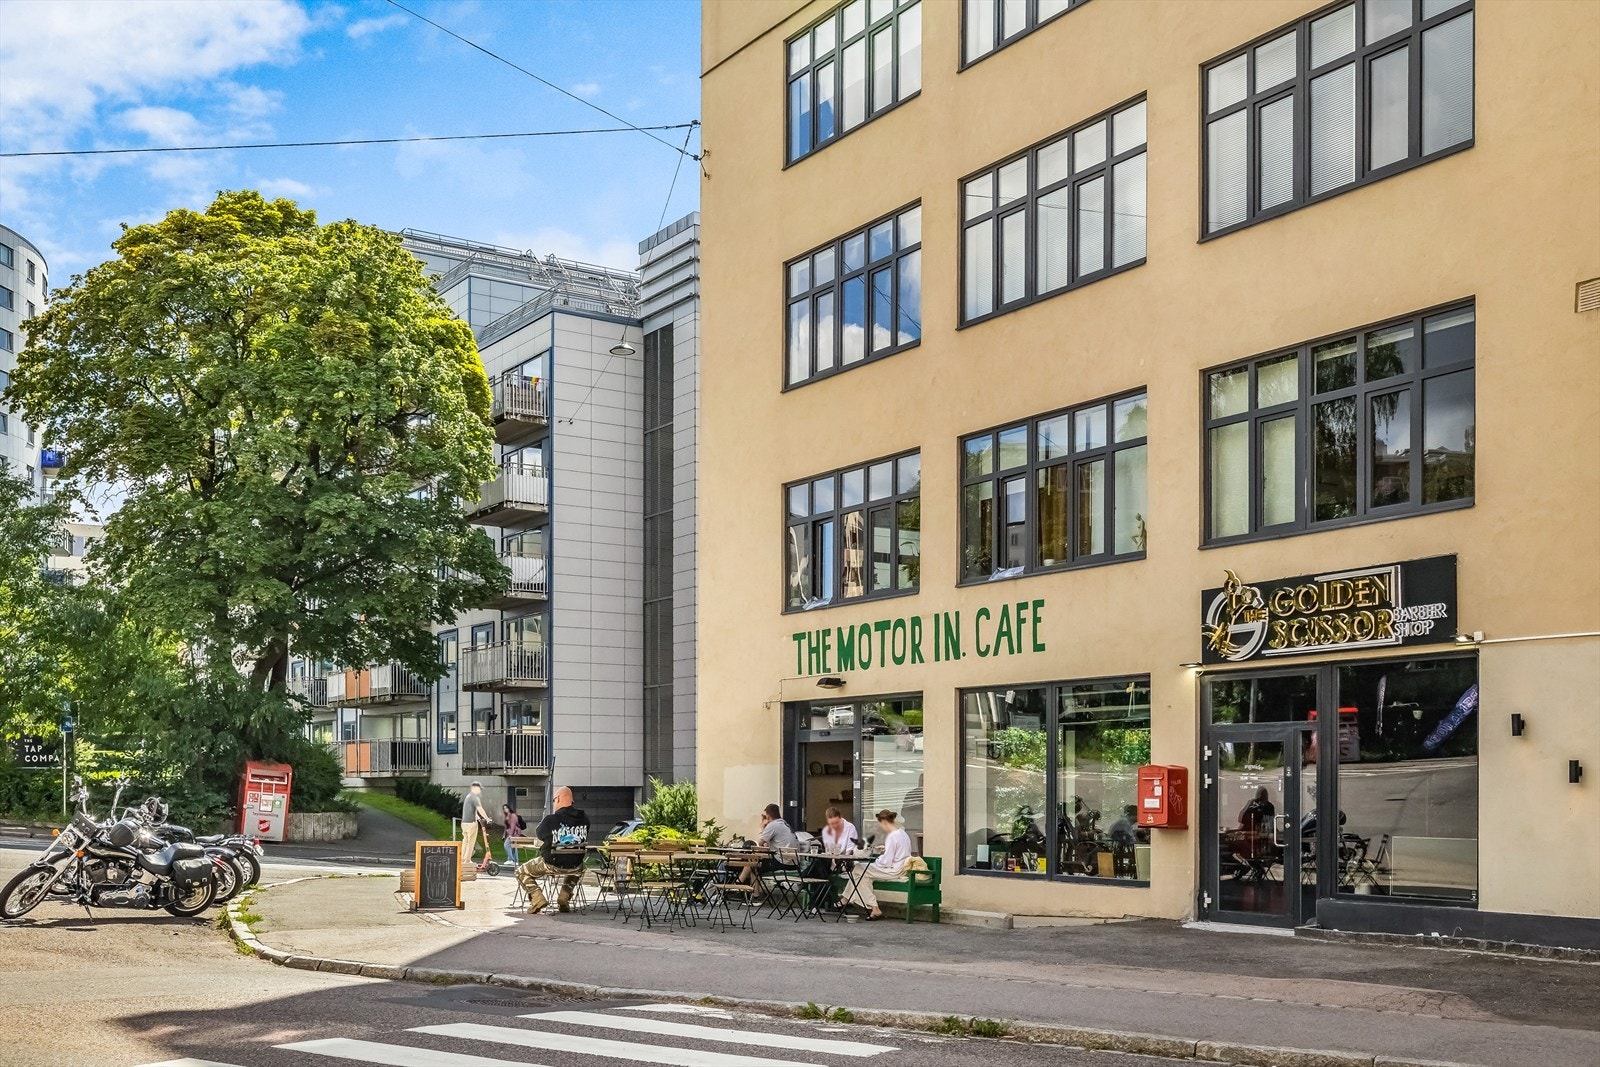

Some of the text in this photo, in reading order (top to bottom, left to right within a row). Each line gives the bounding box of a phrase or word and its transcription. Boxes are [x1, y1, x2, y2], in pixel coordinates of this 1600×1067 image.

[1269, 573, 1391, 616] GOLDEN
[1393, 602, 1448, 622] BARBER
[792, 598, 1046, 676] THE MOTOR IN. CAFE
[1269, 608, 1395, 649] SCISSOR
[1394, 619, 1435, 637] SHOP
[24, 745, 43, 753] TAP
[24, 754, 60, 763] COMPA
